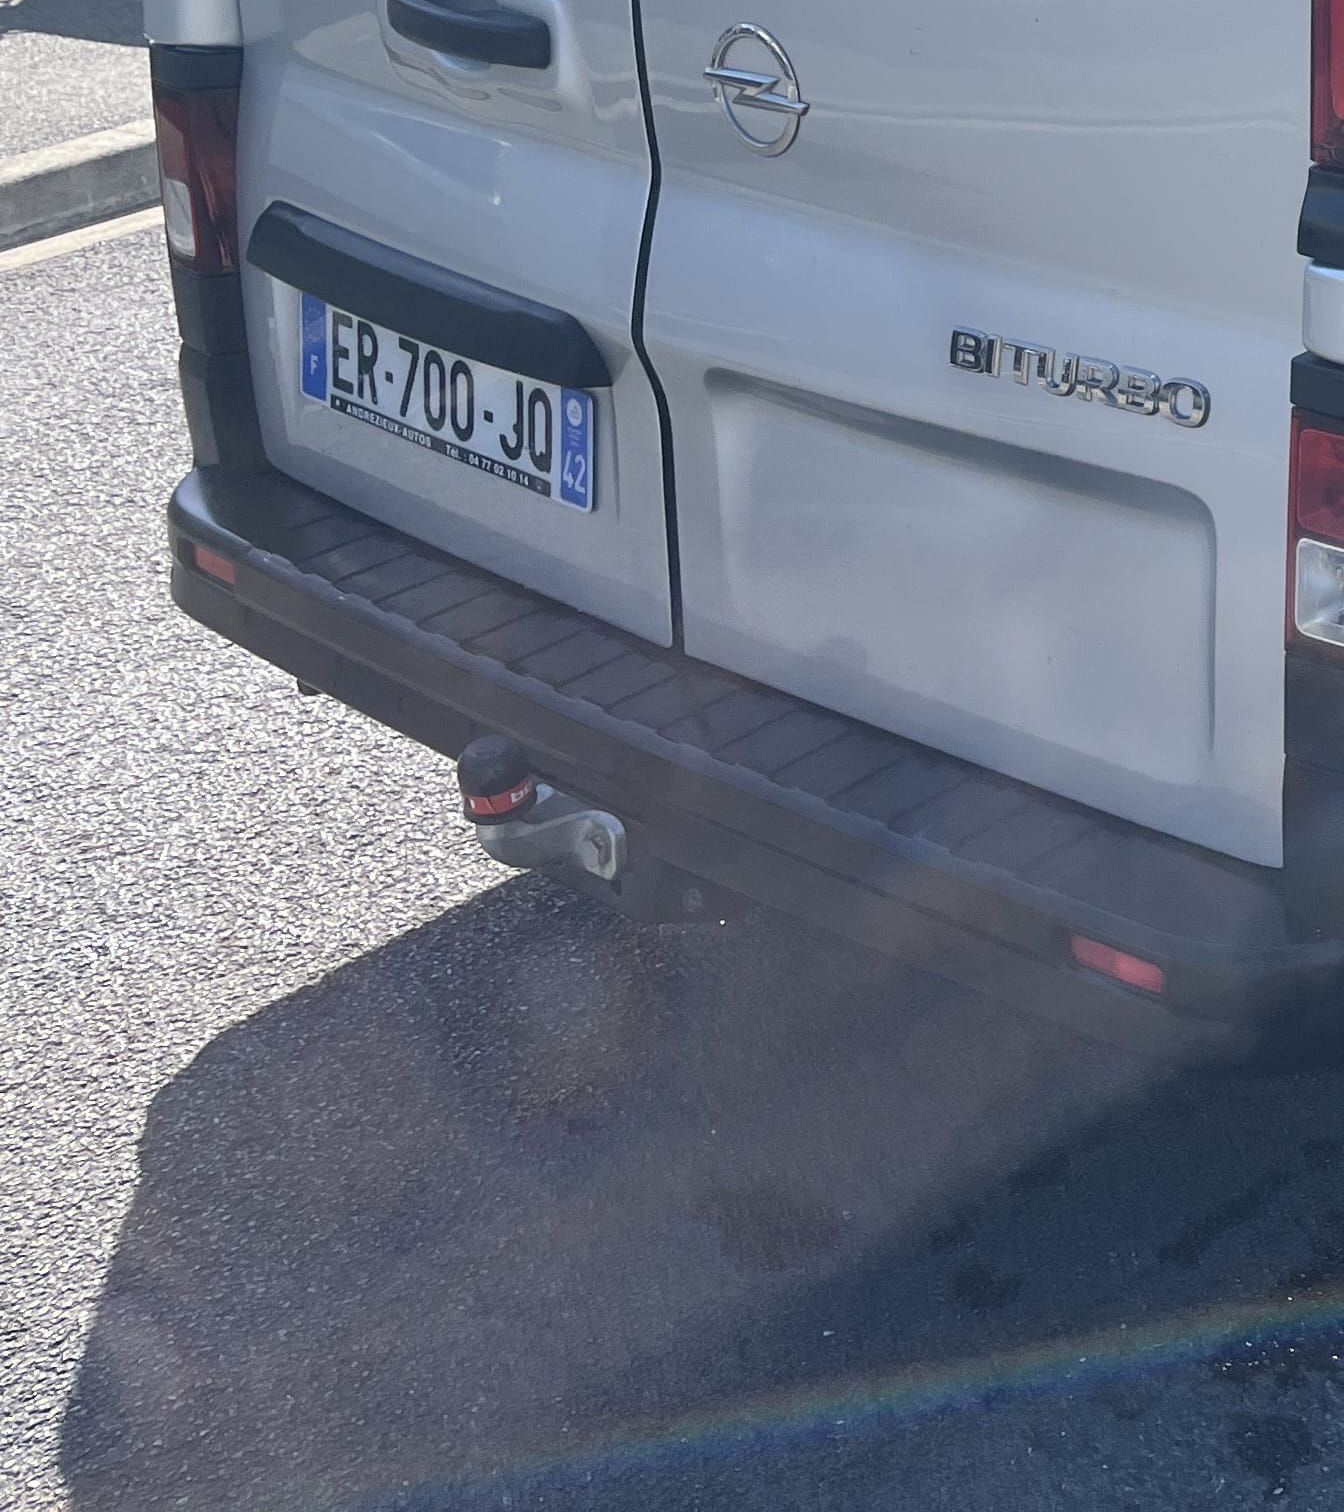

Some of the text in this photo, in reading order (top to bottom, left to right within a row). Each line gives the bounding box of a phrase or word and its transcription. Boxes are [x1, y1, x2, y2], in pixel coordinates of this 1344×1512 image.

[949, 325, 1211, 428] BITURBO
[481, 458, 491, 471] 77
[494, 463, 504, 476] 02
[507, 468, 517, 481] 10
[519, 473, 529, 486] 14
[562, 450, 586, 494] 42
